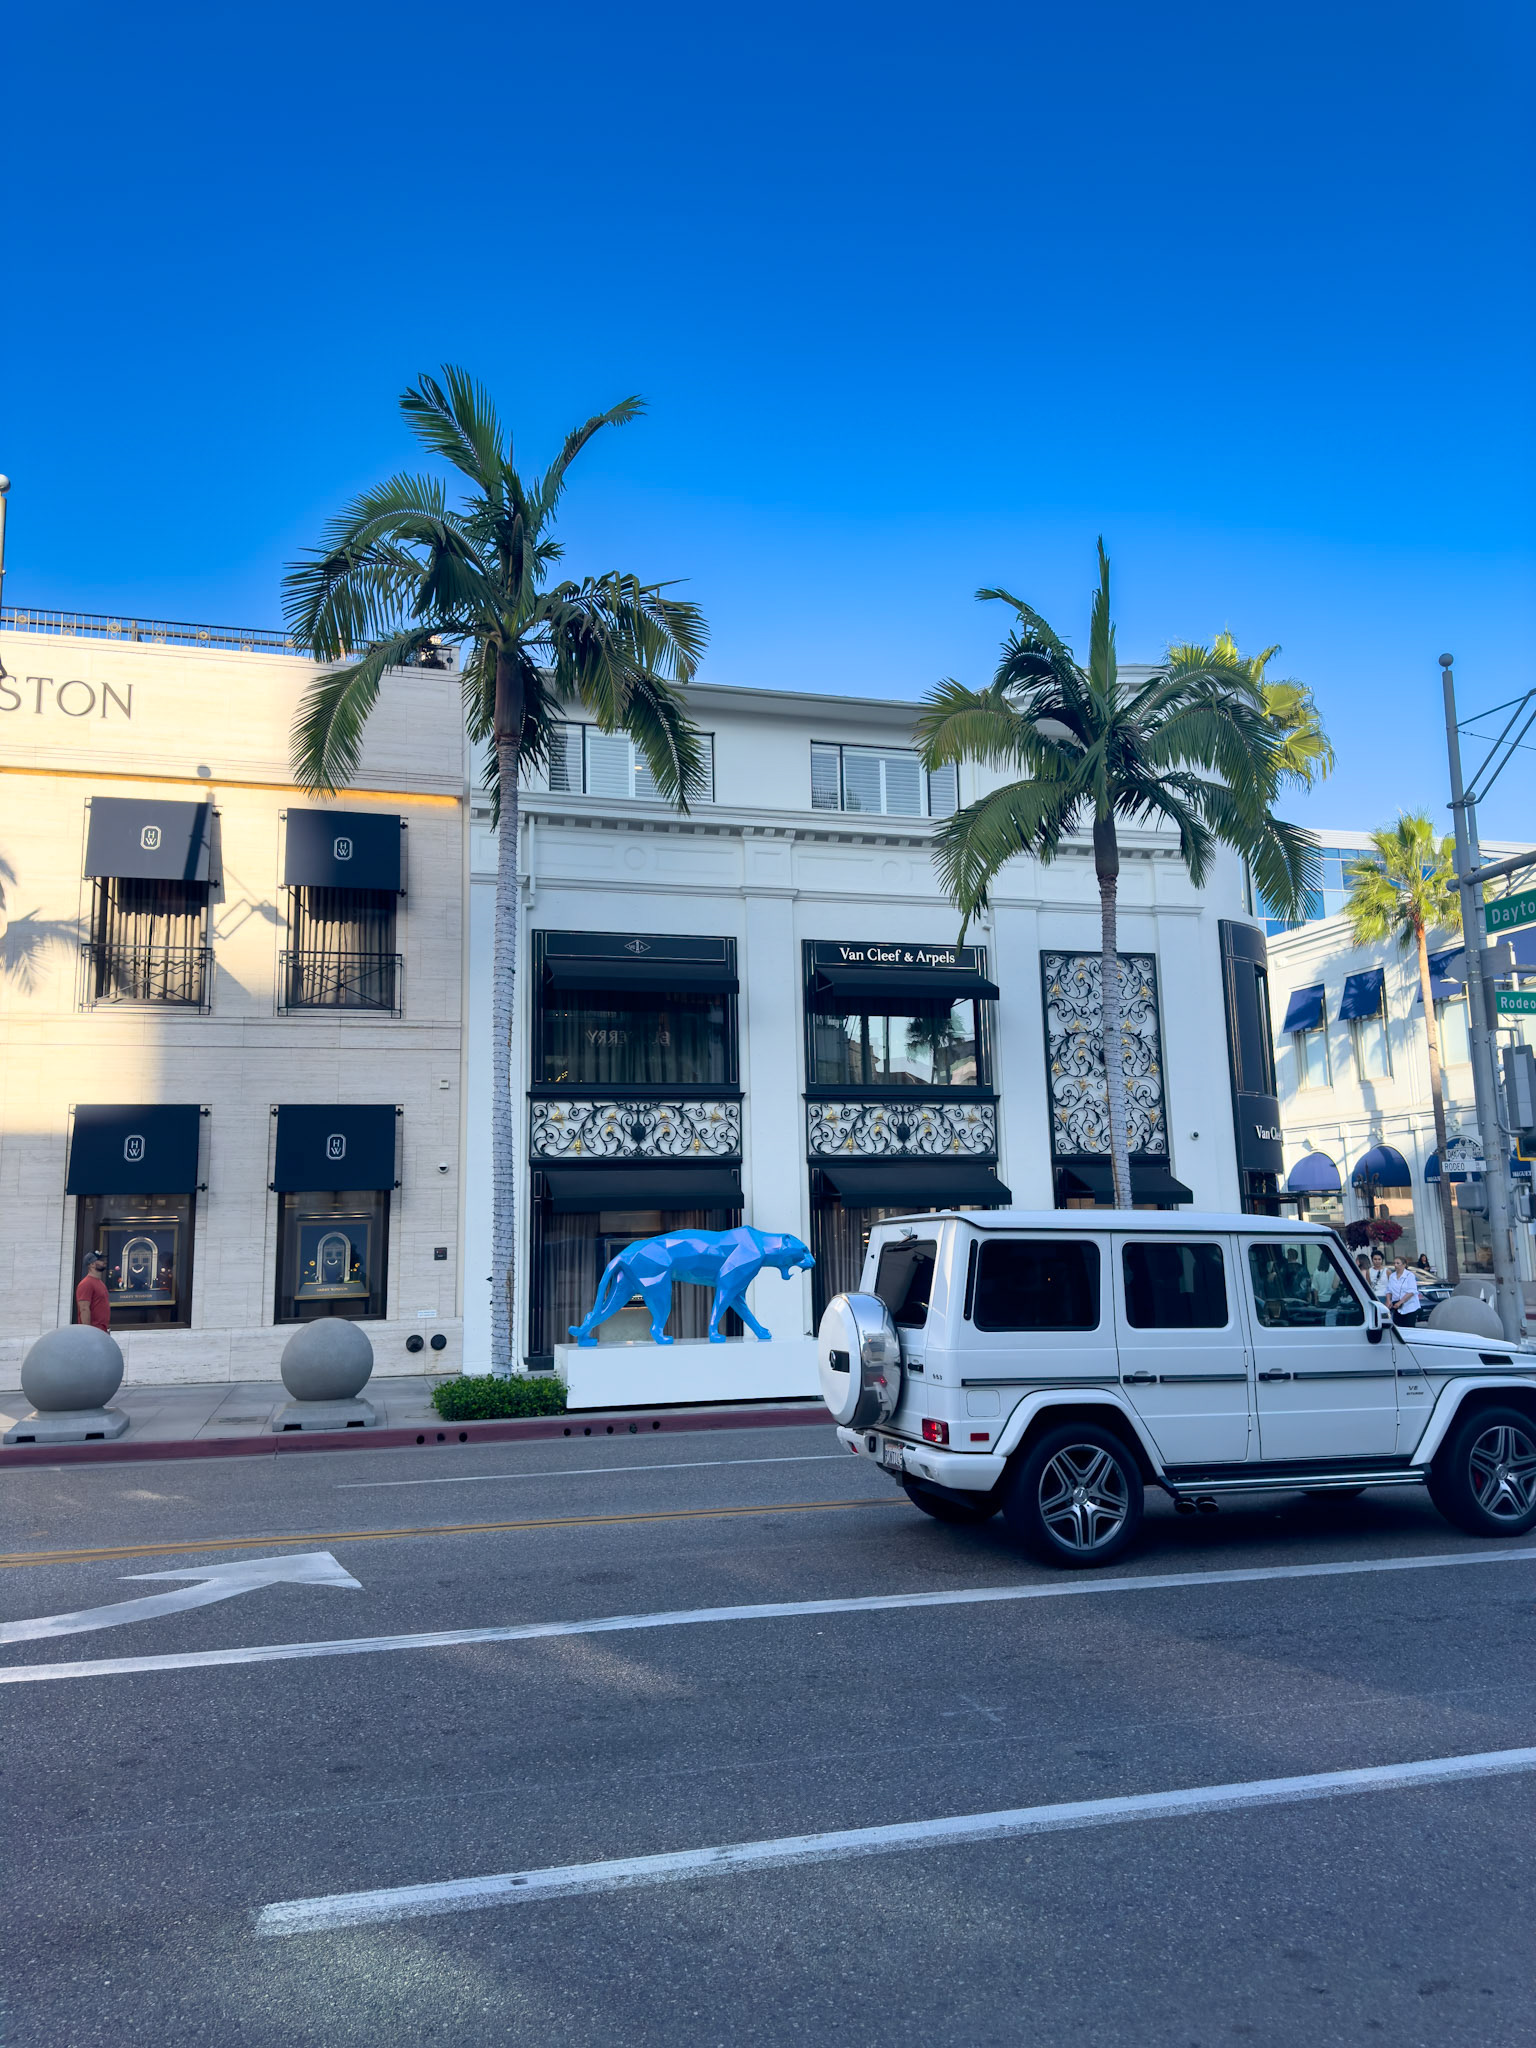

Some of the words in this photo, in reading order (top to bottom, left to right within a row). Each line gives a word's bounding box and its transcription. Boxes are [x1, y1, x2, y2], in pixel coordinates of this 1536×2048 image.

[1491, 900, 1536, 925] Dayto
[839, 947, 864, 961] Van
[866, 947, 902, 962] Cleef
[904, 952, 914, 962] &
[916, 950, 956, 967] Arpels
[1500, 996, 1536, 1010] Rodeo
[1255, 1124, 1270, 1140] Van
[1444, 1162, 1465, 1172] RODEO
